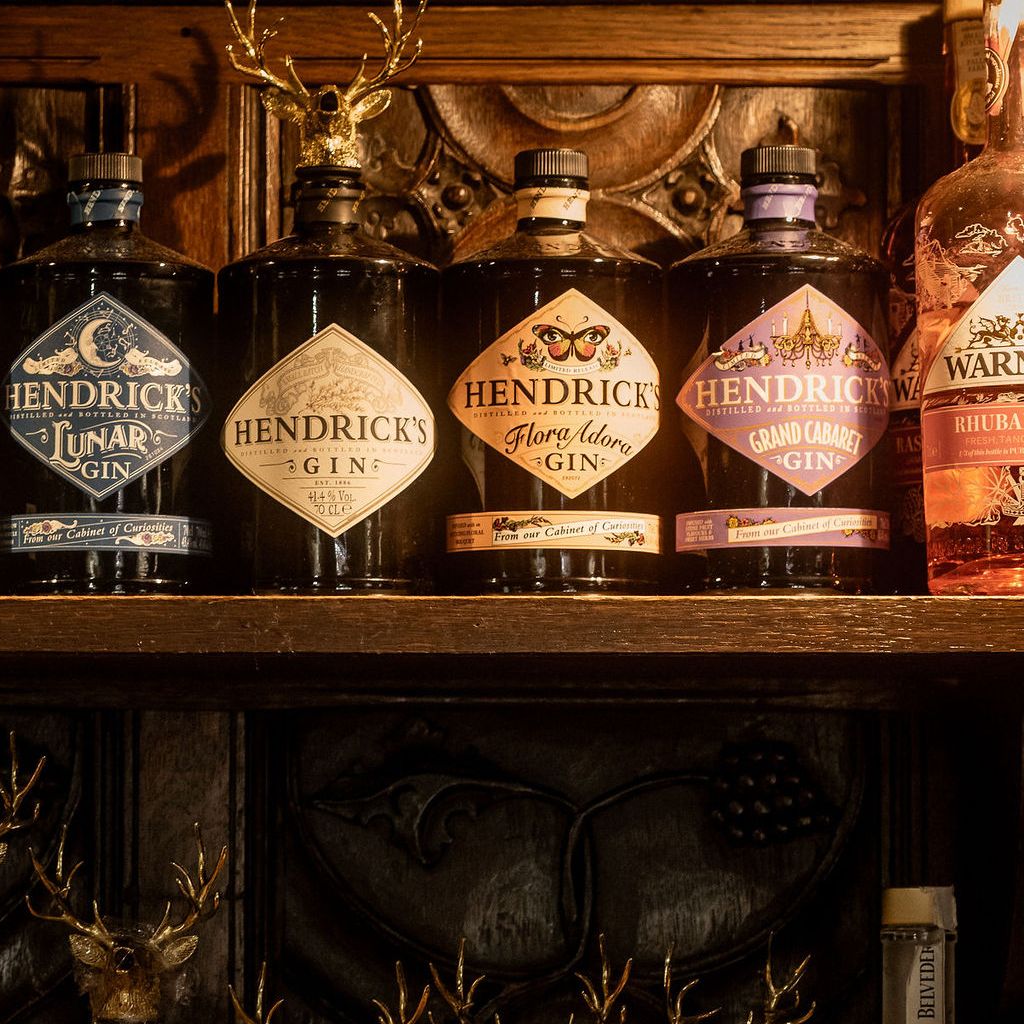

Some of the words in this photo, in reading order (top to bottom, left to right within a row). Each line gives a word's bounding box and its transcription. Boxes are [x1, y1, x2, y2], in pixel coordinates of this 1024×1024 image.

[5, 380, 202, 415] HENDRICK'S
[465, 378, 660, 411] HENDRICK'S
[695, 375, 889, 409] HENDRICK'S
[474, 410, 527, 418] DISTILLED
[706, 405, 762, 416] DISTILLED
[234, 415, 427, 446] HENDRICK'S
[49, 419, 148, 472] LUNAR
[303, 457, 365, 474] GIN
[545, 453, 599, 471] GIN
[782, 452, 837, 470] GIN
[81, 462, 131, 480] GIN
[66, 527, 104, 540] Cabinet
[109, 523, 121, 535] of
[123, 522, 173, 534] Curiosities
[494, 530, 519, 541] From
[523, 530, 540, 538] our
[545, 525, 584, 537] Cabinet
[735, 529, 760, 539] From
[764, 527, 780, 537] our
[783, 521, 819, 533] Cabinet
[822, 518, 832, 530] of
